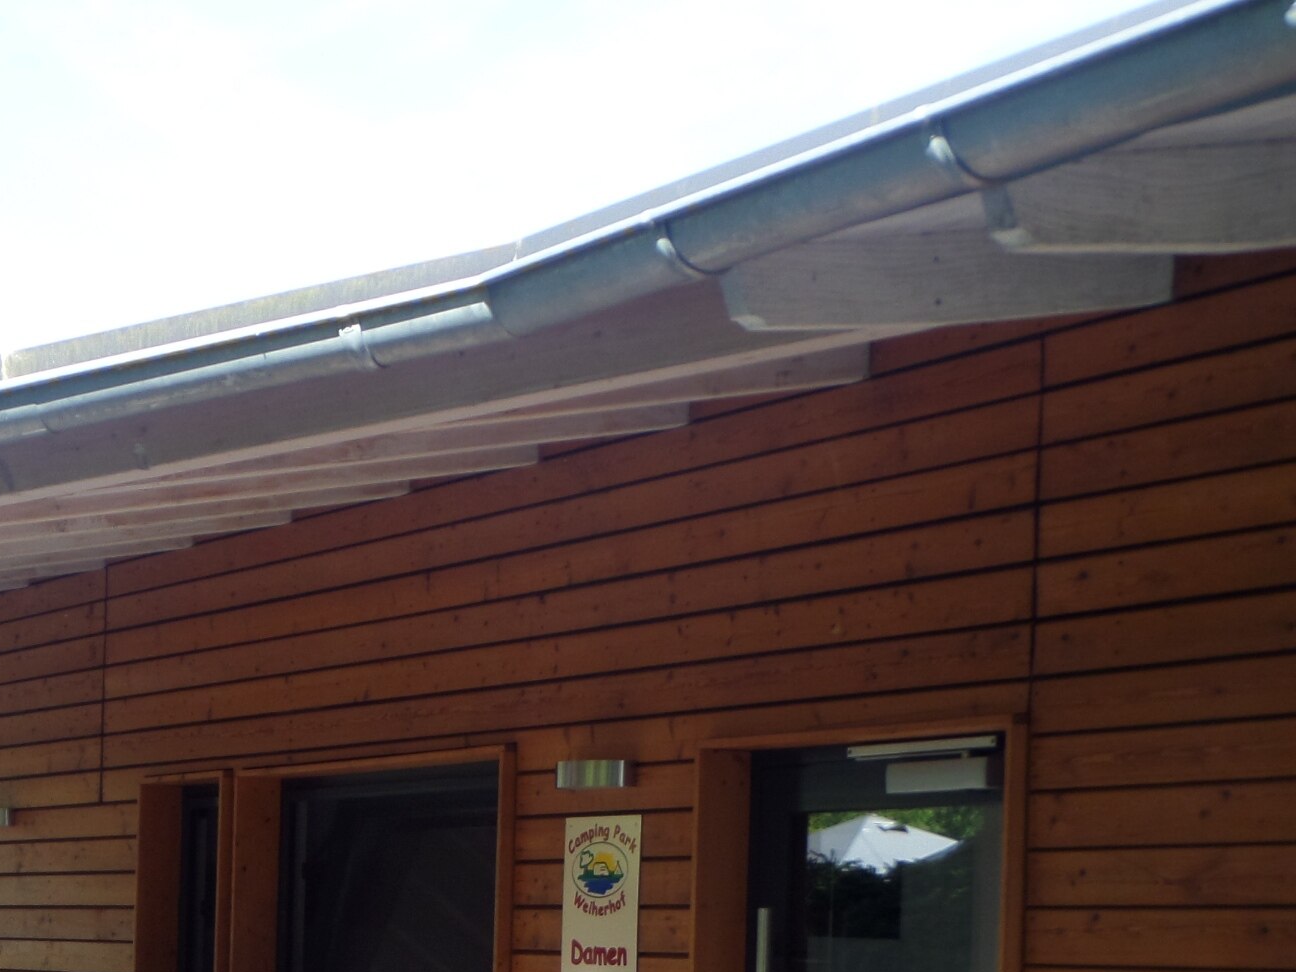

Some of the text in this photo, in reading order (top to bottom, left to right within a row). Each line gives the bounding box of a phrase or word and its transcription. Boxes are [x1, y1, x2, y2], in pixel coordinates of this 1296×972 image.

[568, 823, 637, 854] Camping Park
[573, 890, 626, 917] Weiherhof
[570, 938, 627, 967] Damen
